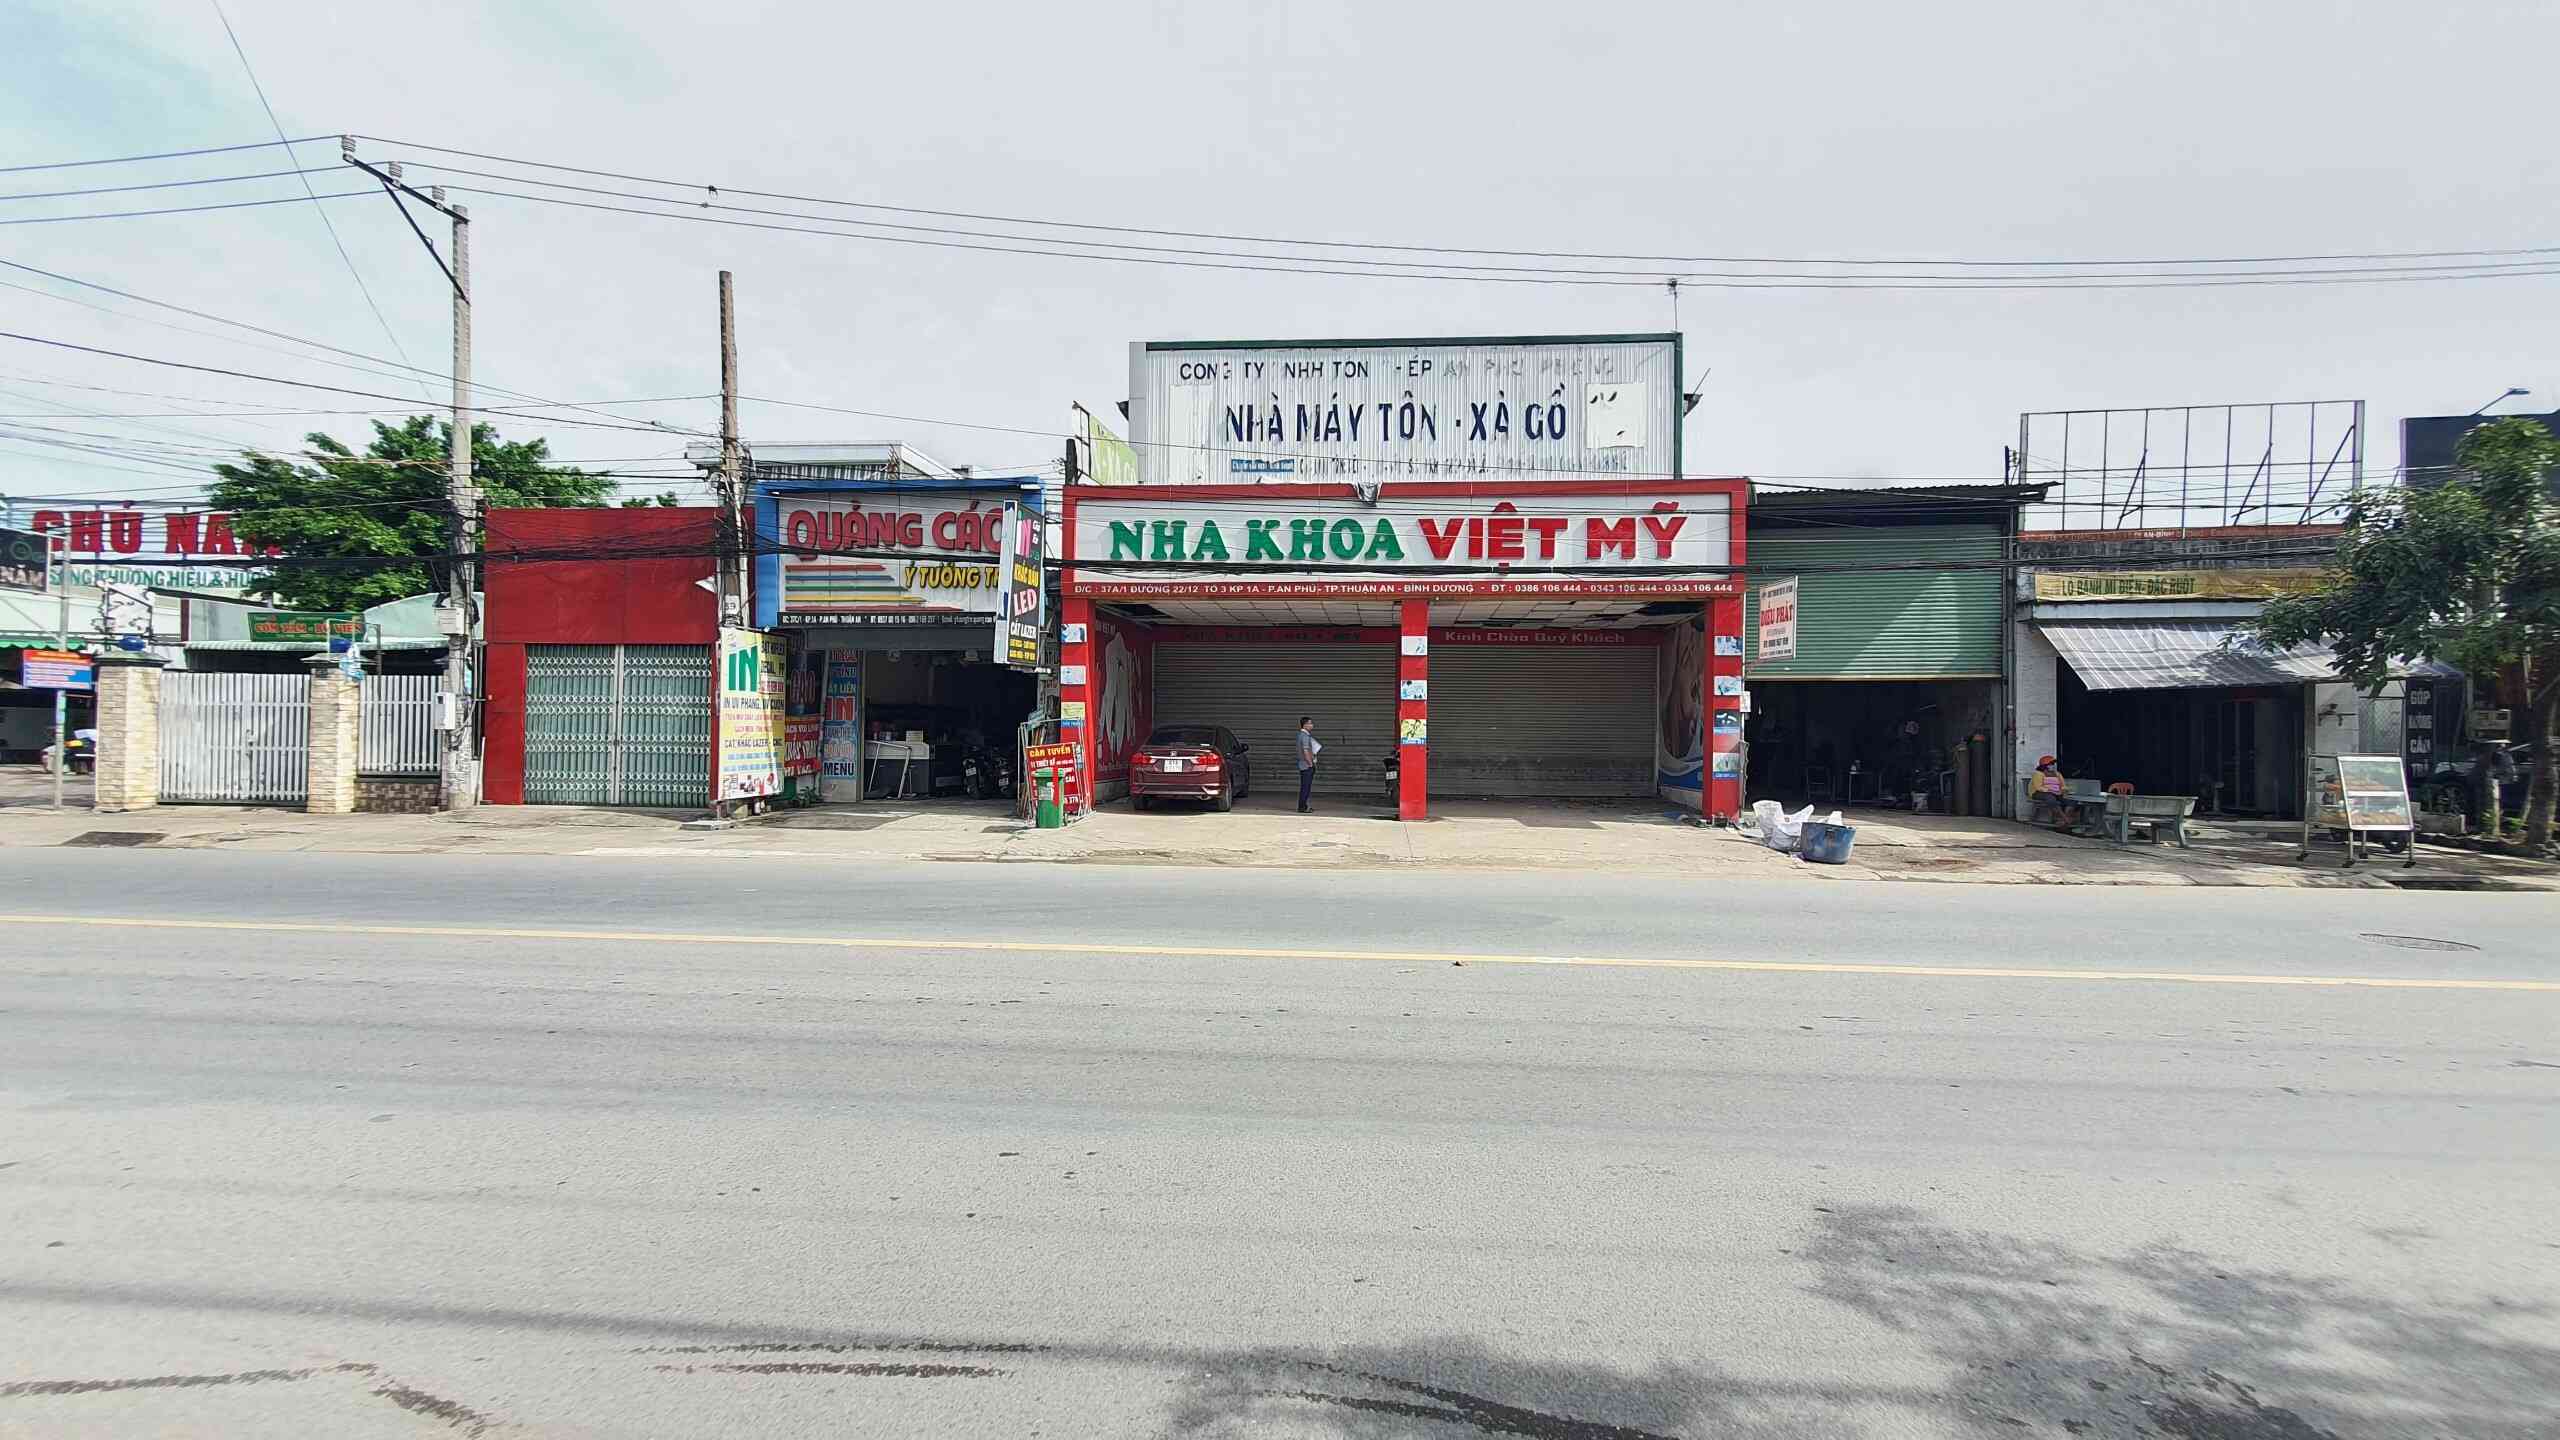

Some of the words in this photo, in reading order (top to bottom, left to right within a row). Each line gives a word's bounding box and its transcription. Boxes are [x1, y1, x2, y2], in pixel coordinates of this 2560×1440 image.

[1245, 361, 1264, 378] TY
[1276, 361, 1323, 378] NHH
[1227, 392, 1283, 442] NHÀ
[1297, 392, 1364, 442] MÁY
[1379, 390, 1437, 441] TÔN
[1470, 390, 1509, 441] XÀ
[787, 500, 923, 562] QUẢNG
[1109, 519, 1230, 560] NHA
[1246, 518, 1404, 560] KHOA
[1418, 502, 1568, 575] VIỆT
[1587, 501, 1688, 560] MỸ
[904, 560, 917, 588] Ý
[1013, 588, 1037, 617] LED
[1101, 584, 1127, 593] 37A/1
[1172, 584, 1199, 593] 22/12
[1220, 584, 1227, 593] 3
[1229, 584, 1243, 593] KP
[1247, 584, 1260, 593] 1A
[1379, 584, 1395, 593] AN
[1515, 584, 1539, 592] 0386
[1542, 584, 1560, 592] 106
[1563, 584, 1581, 592] 444
[1638, 584, 1657, 592] 444
[1664, 584, 1690, 592] 0334
[1693, 584, 1711, 592] 106
[1714, 584, 1733, 592] 444
[823, 761, 855, 777] MENU
